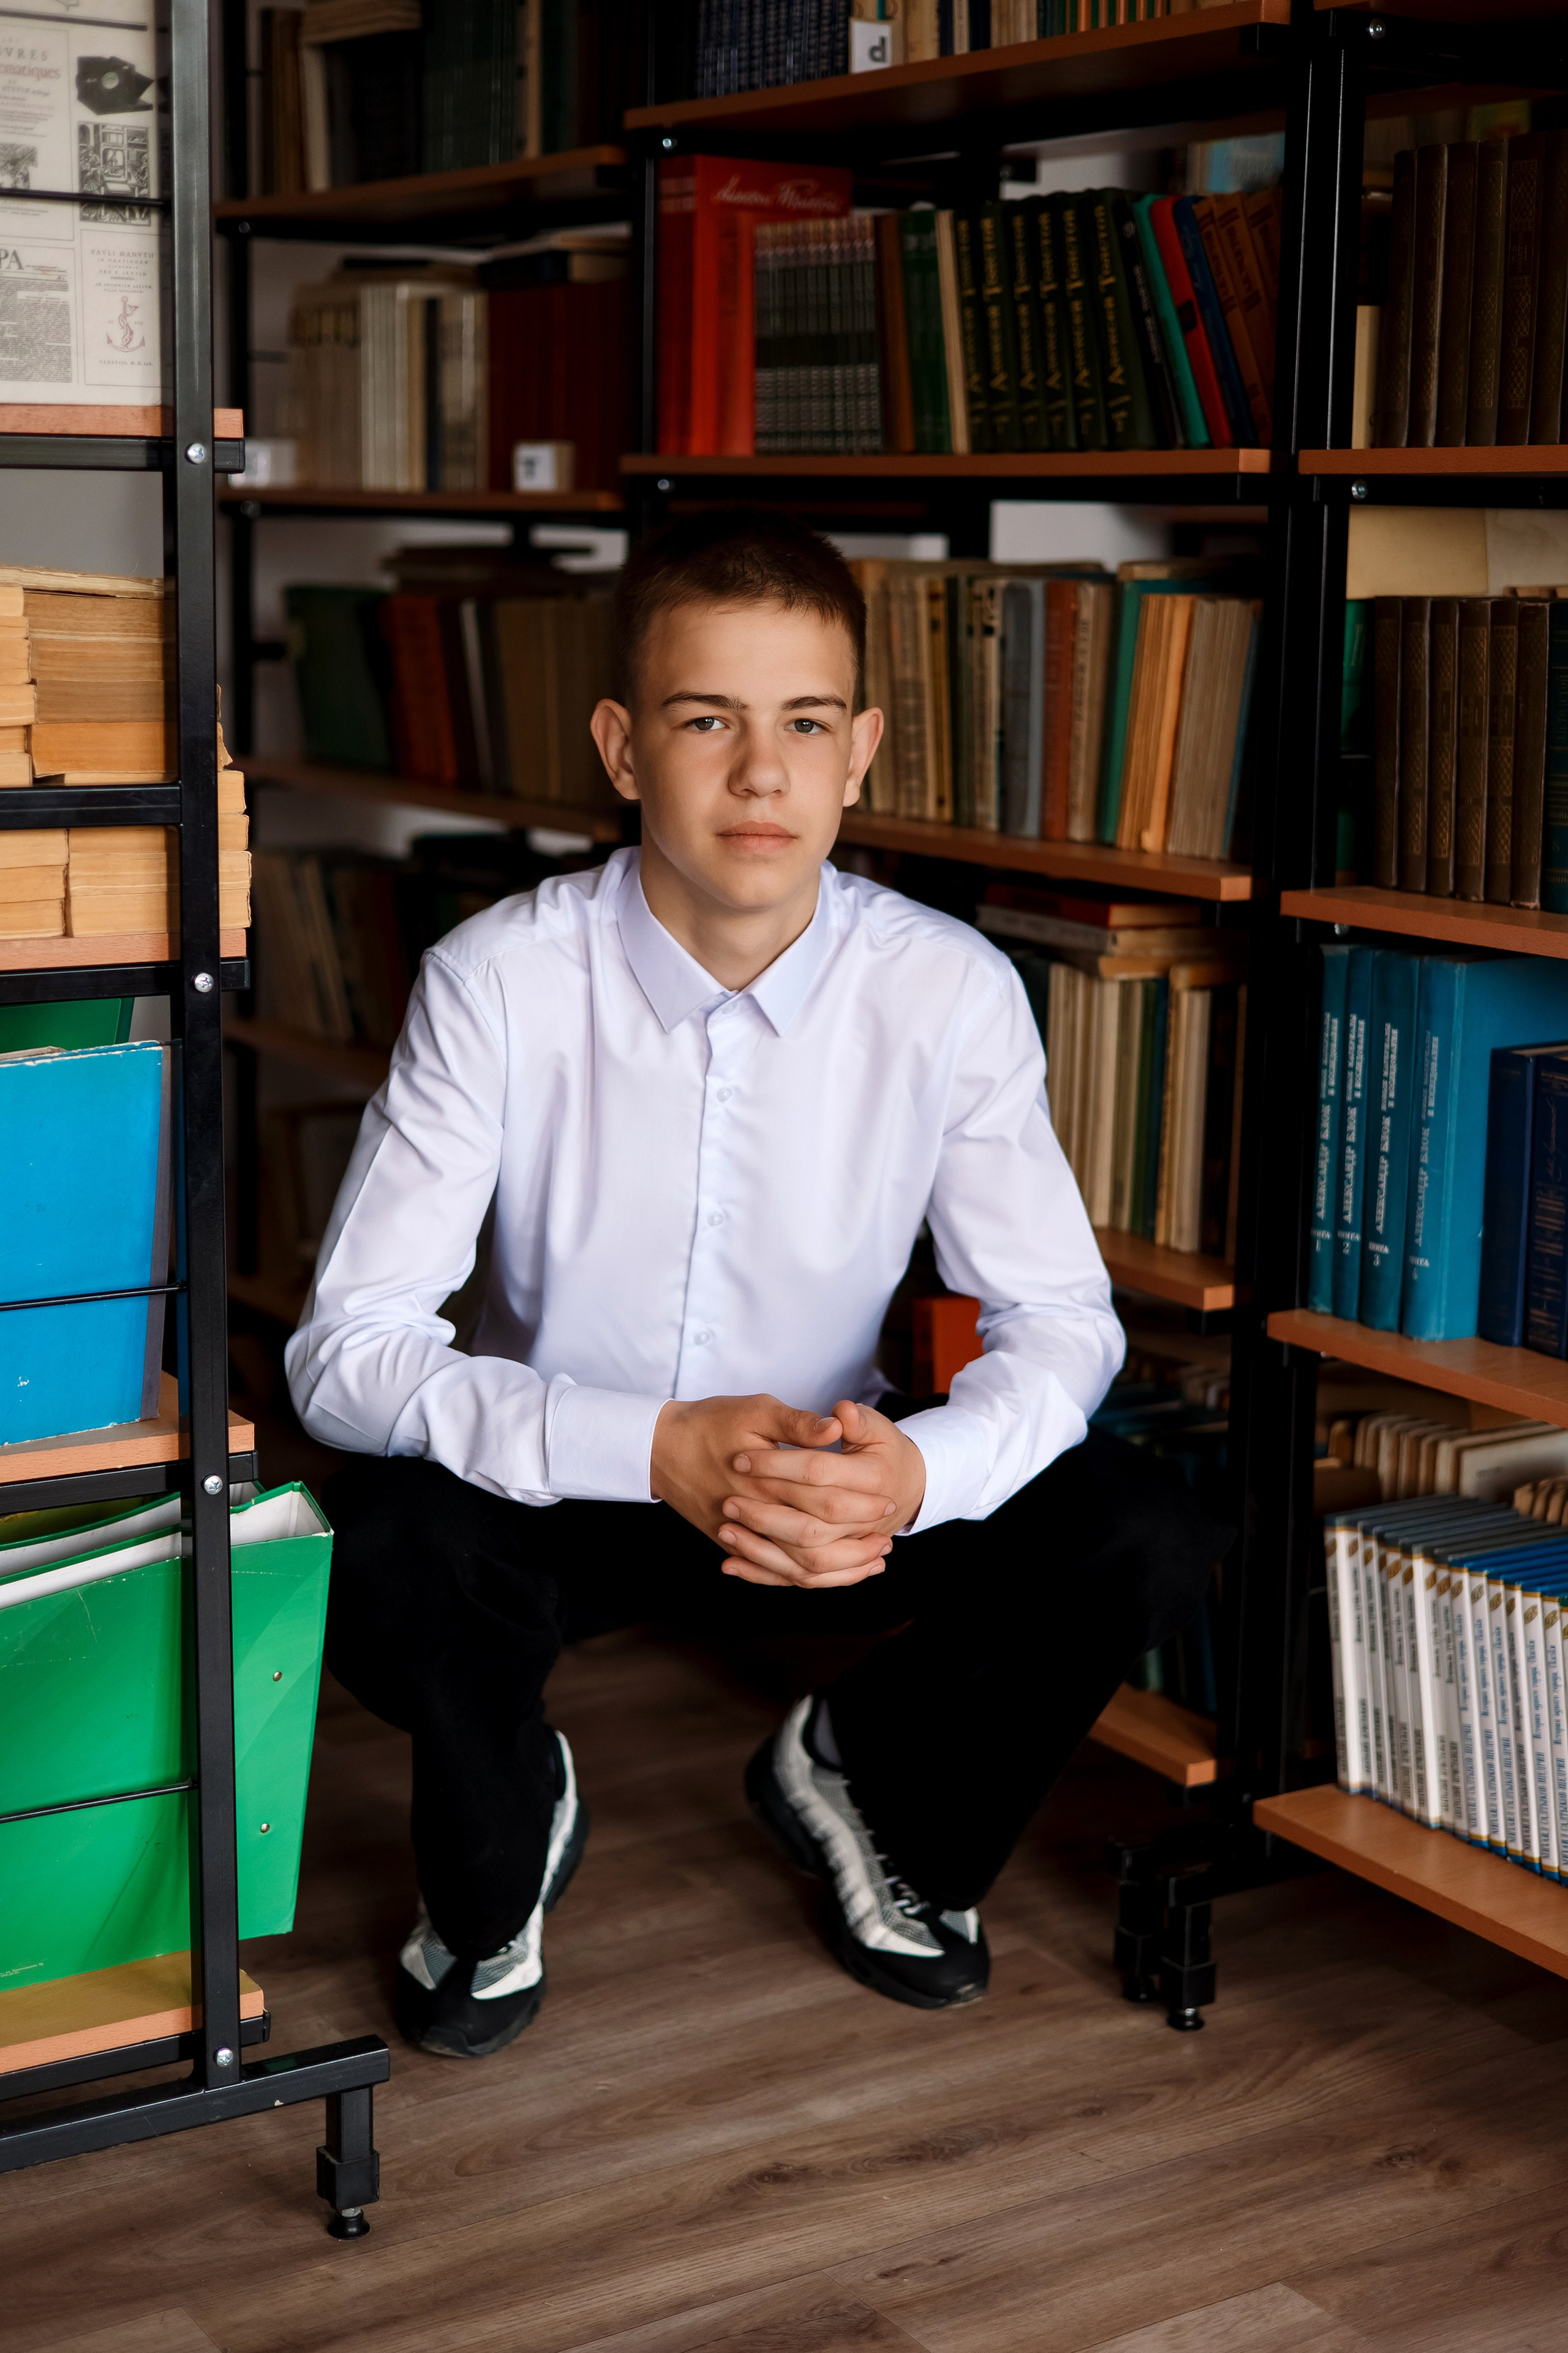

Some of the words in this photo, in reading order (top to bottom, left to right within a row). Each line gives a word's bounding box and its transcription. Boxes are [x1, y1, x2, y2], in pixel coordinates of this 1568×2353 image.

[1380, 1116, 1391, 1153] БЛОК
[1375, 1156, 1389, 1234] АЛЕКСАНДР
[1343, 1242, 1350, 1255] 2
[1373, 1255, 1381, 1266] 3
